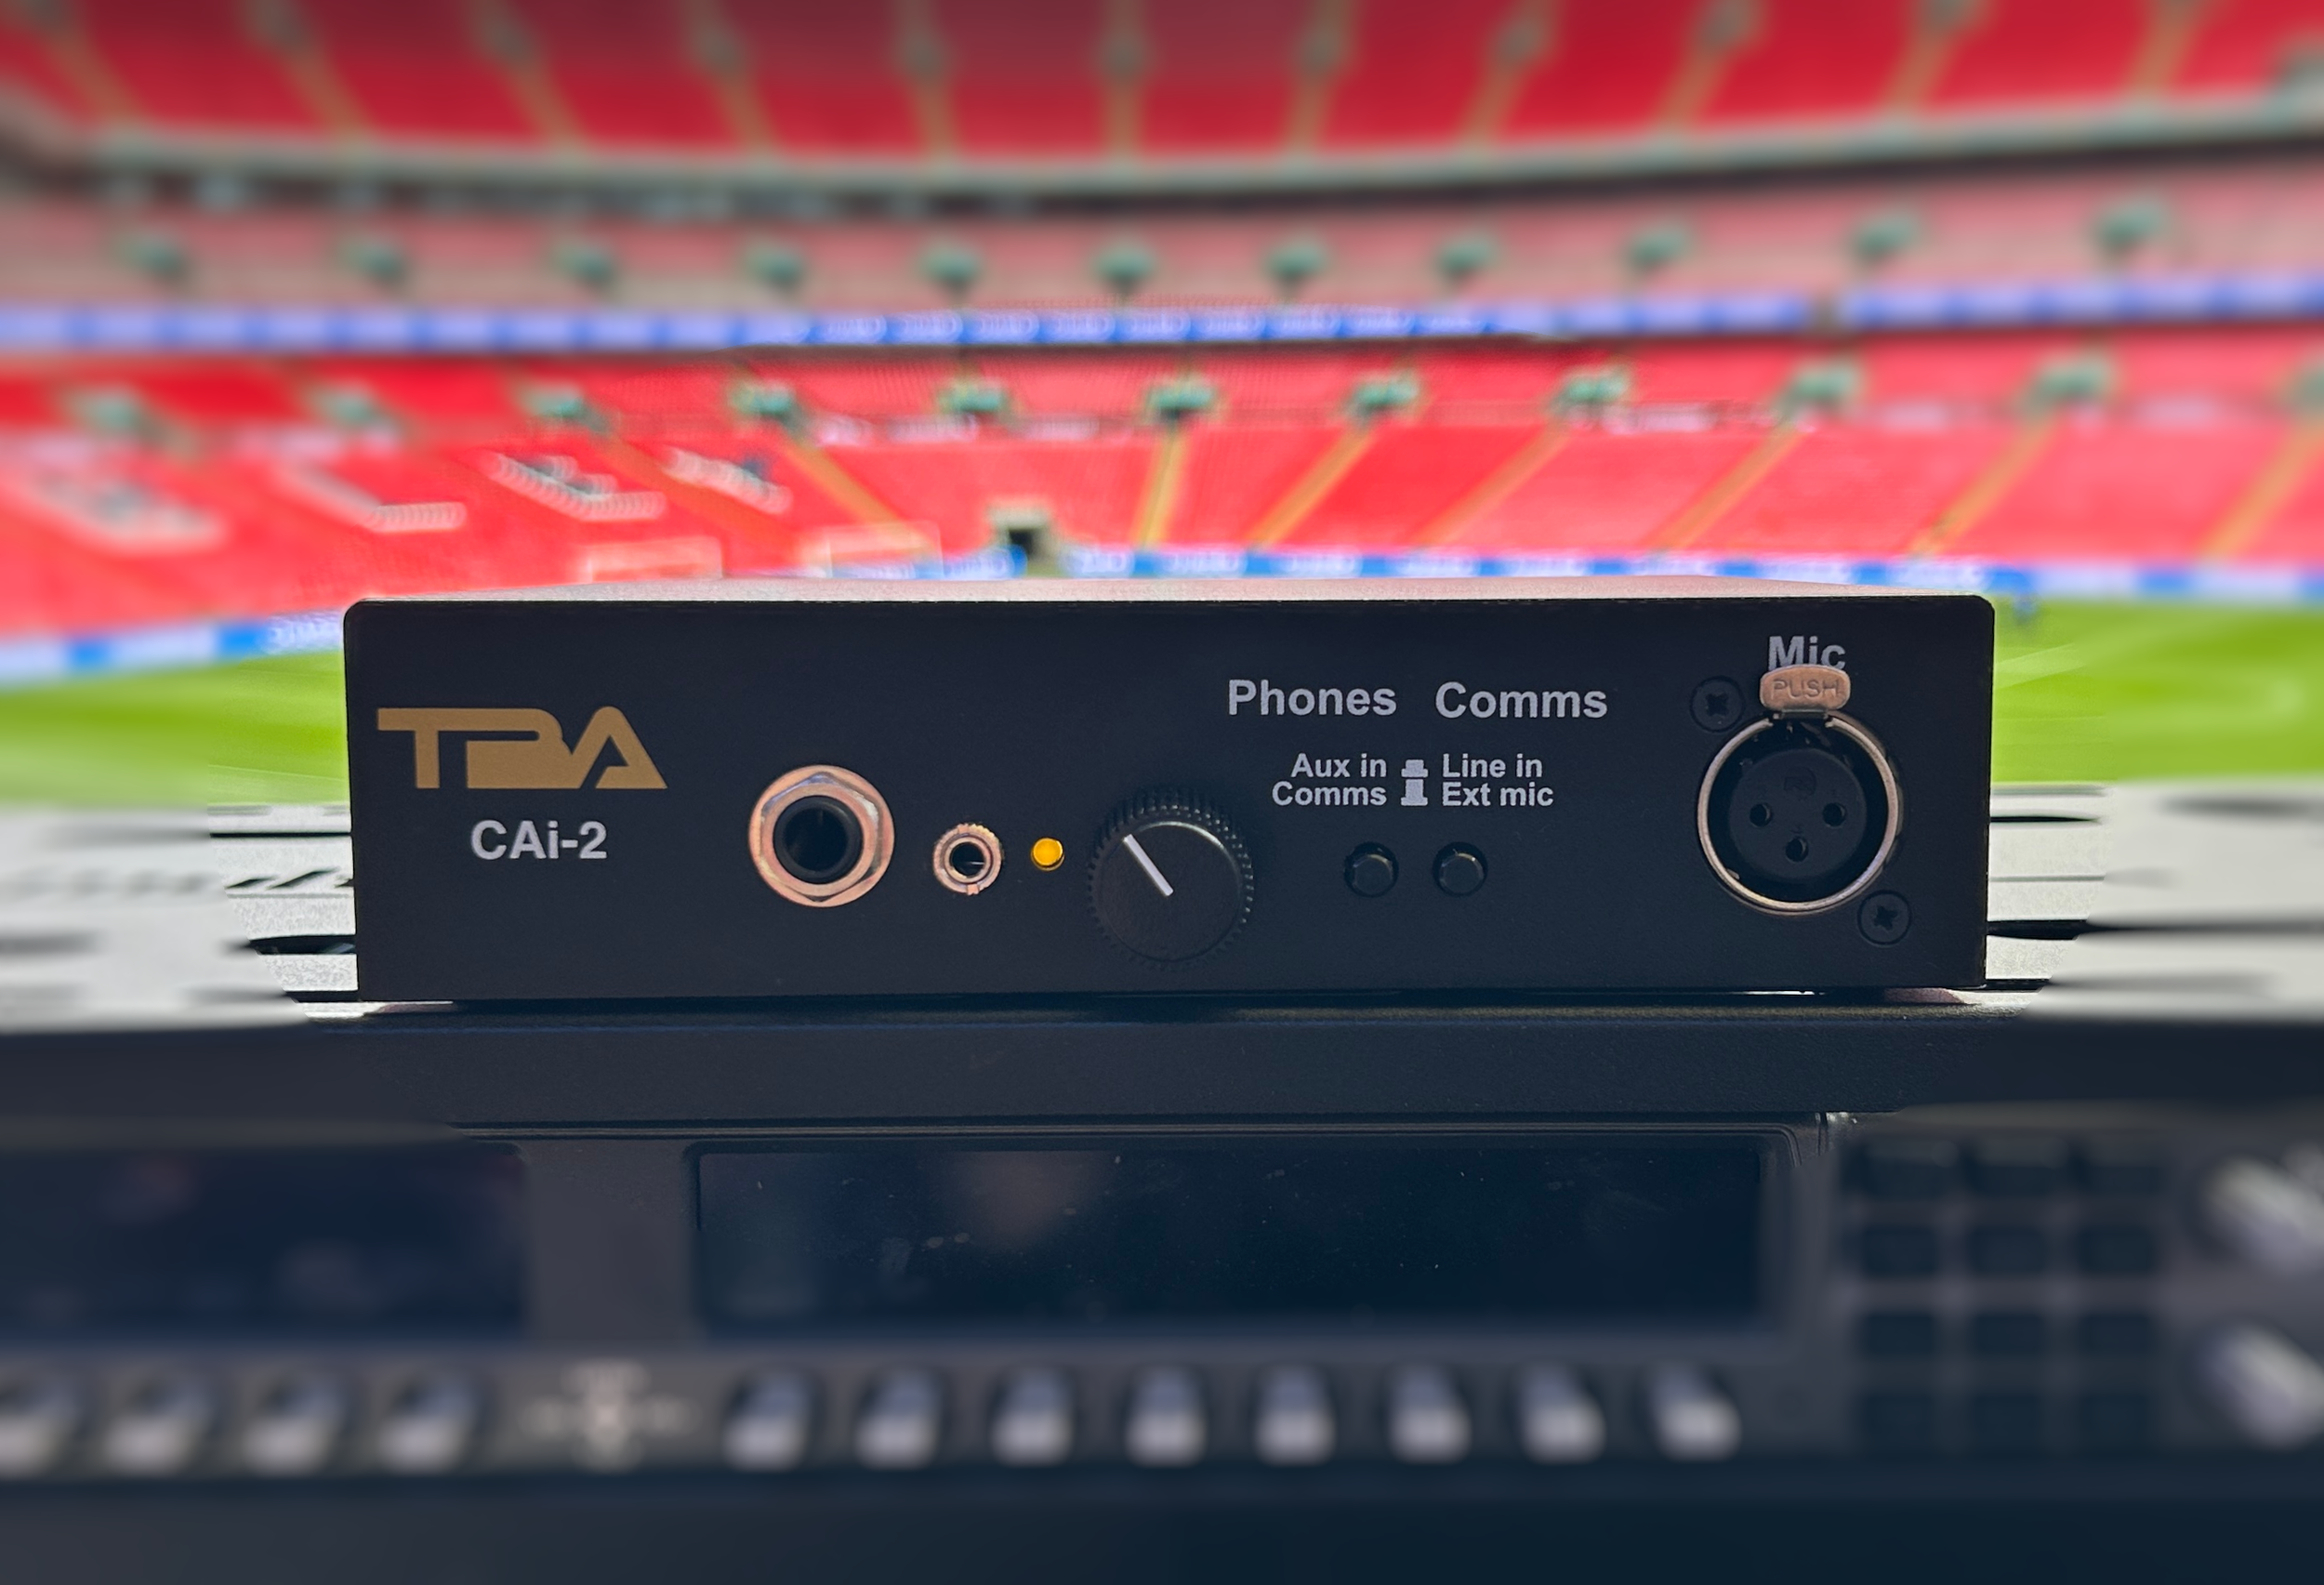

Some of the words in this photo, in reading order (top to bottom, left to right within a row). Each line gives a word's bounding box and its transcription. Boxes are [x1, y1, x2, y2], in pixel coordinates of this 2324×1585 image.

[1768, 635, 1846, 670] Mic
[1228, 680, 1396, 716] Phones
[1435, 681, 1607, 719] Comms
[1771, 679, 1840, 700] PUSH
[1290, 752, 1350, 778] Aux
[1360, 752, 1387, 778] in
[1442, 752, 1506, 778] Line
[1516, 752, 1543, 778] in
[1272, 780, 1387, 806] Comms
[1442, 781, 1491, 806] Ext
[1499, 781, 1554, 806] mic
[470, 819, 607, 860] CAi-2
